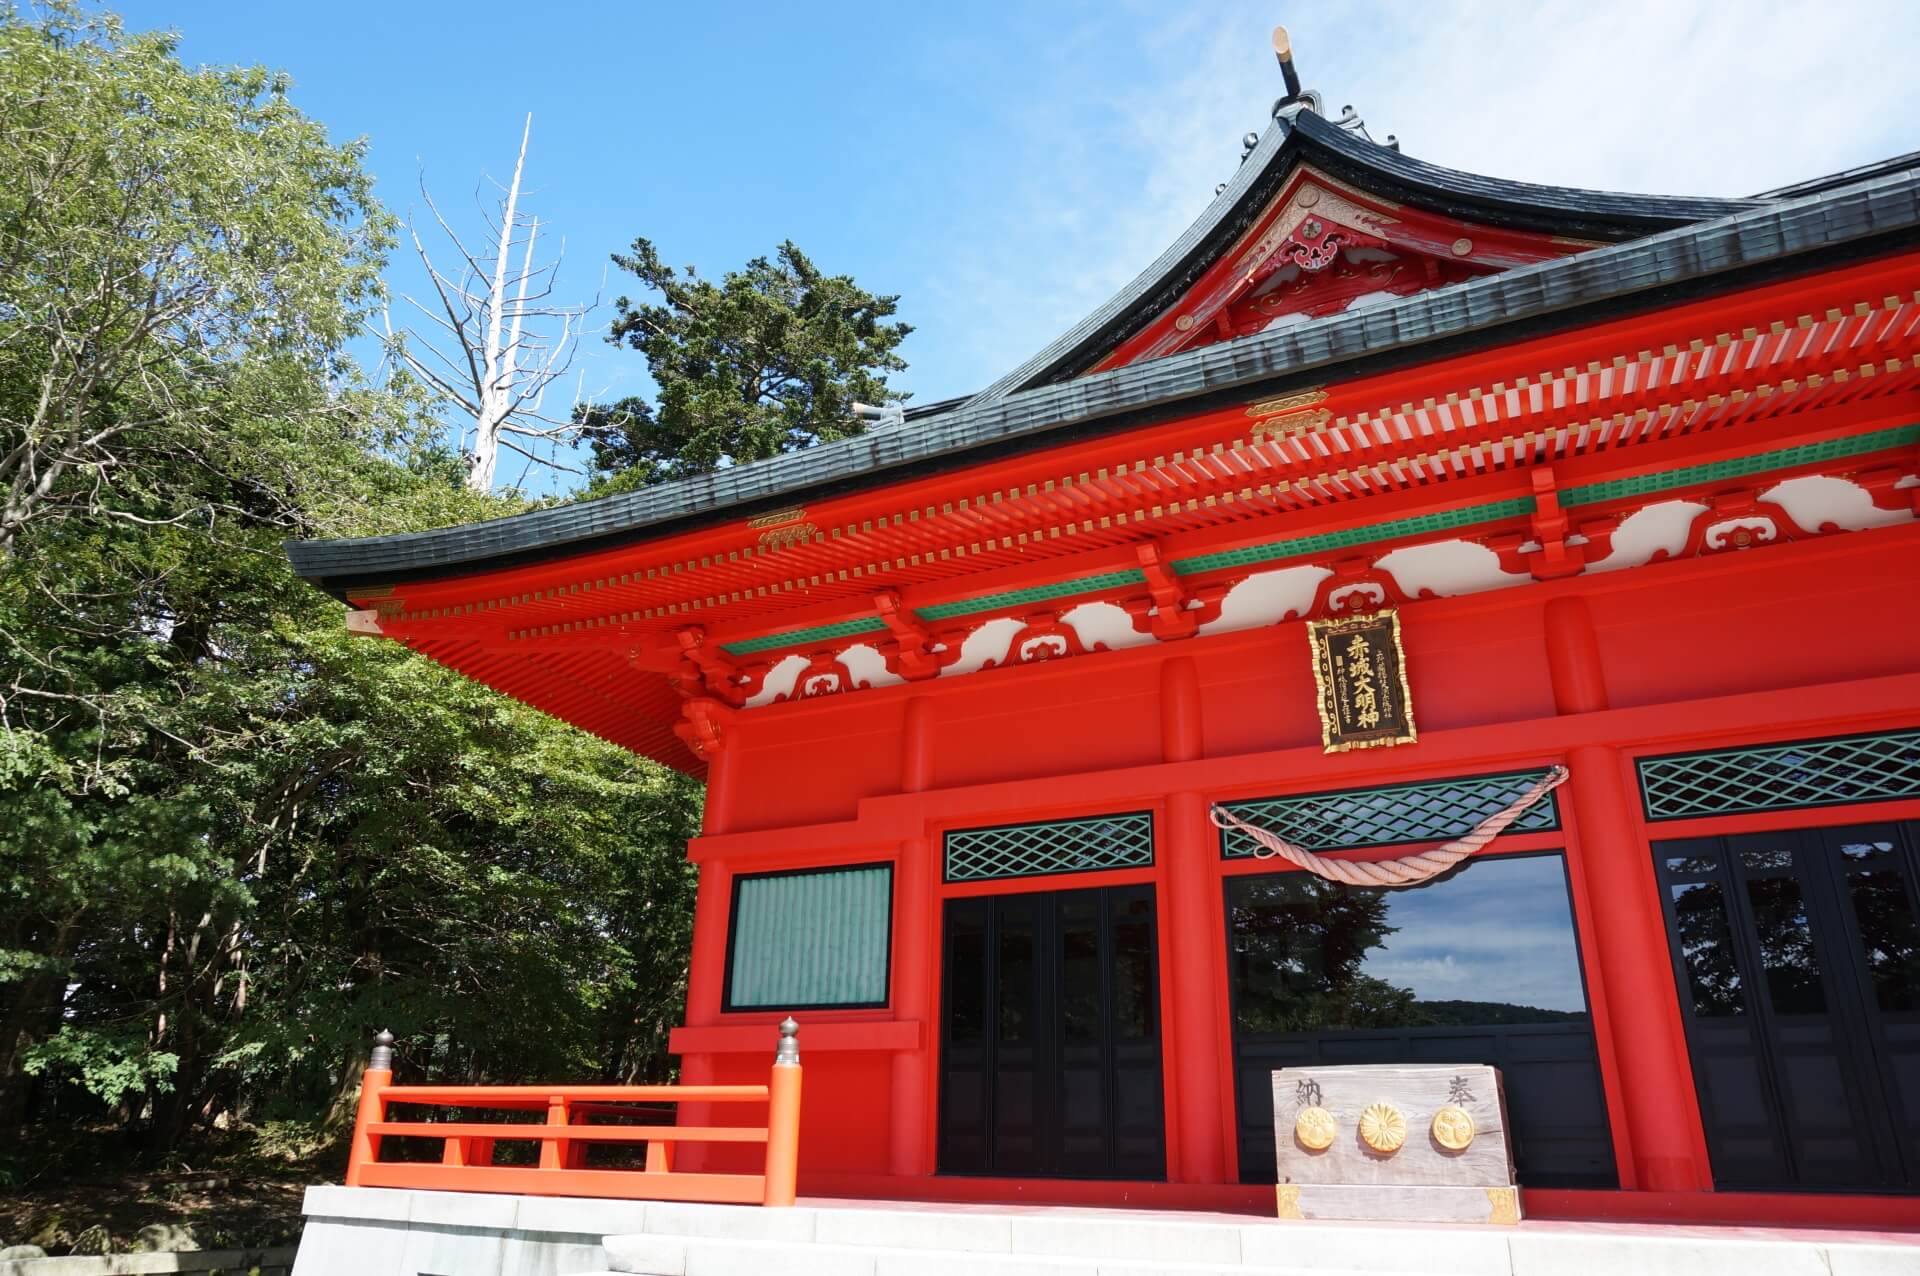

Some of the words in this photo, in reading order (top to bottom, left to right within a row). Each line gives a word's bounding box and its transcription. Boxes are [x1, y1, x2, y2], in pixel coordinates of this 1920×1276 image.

[1347, 634, 1380, 729] 赤城大明神
